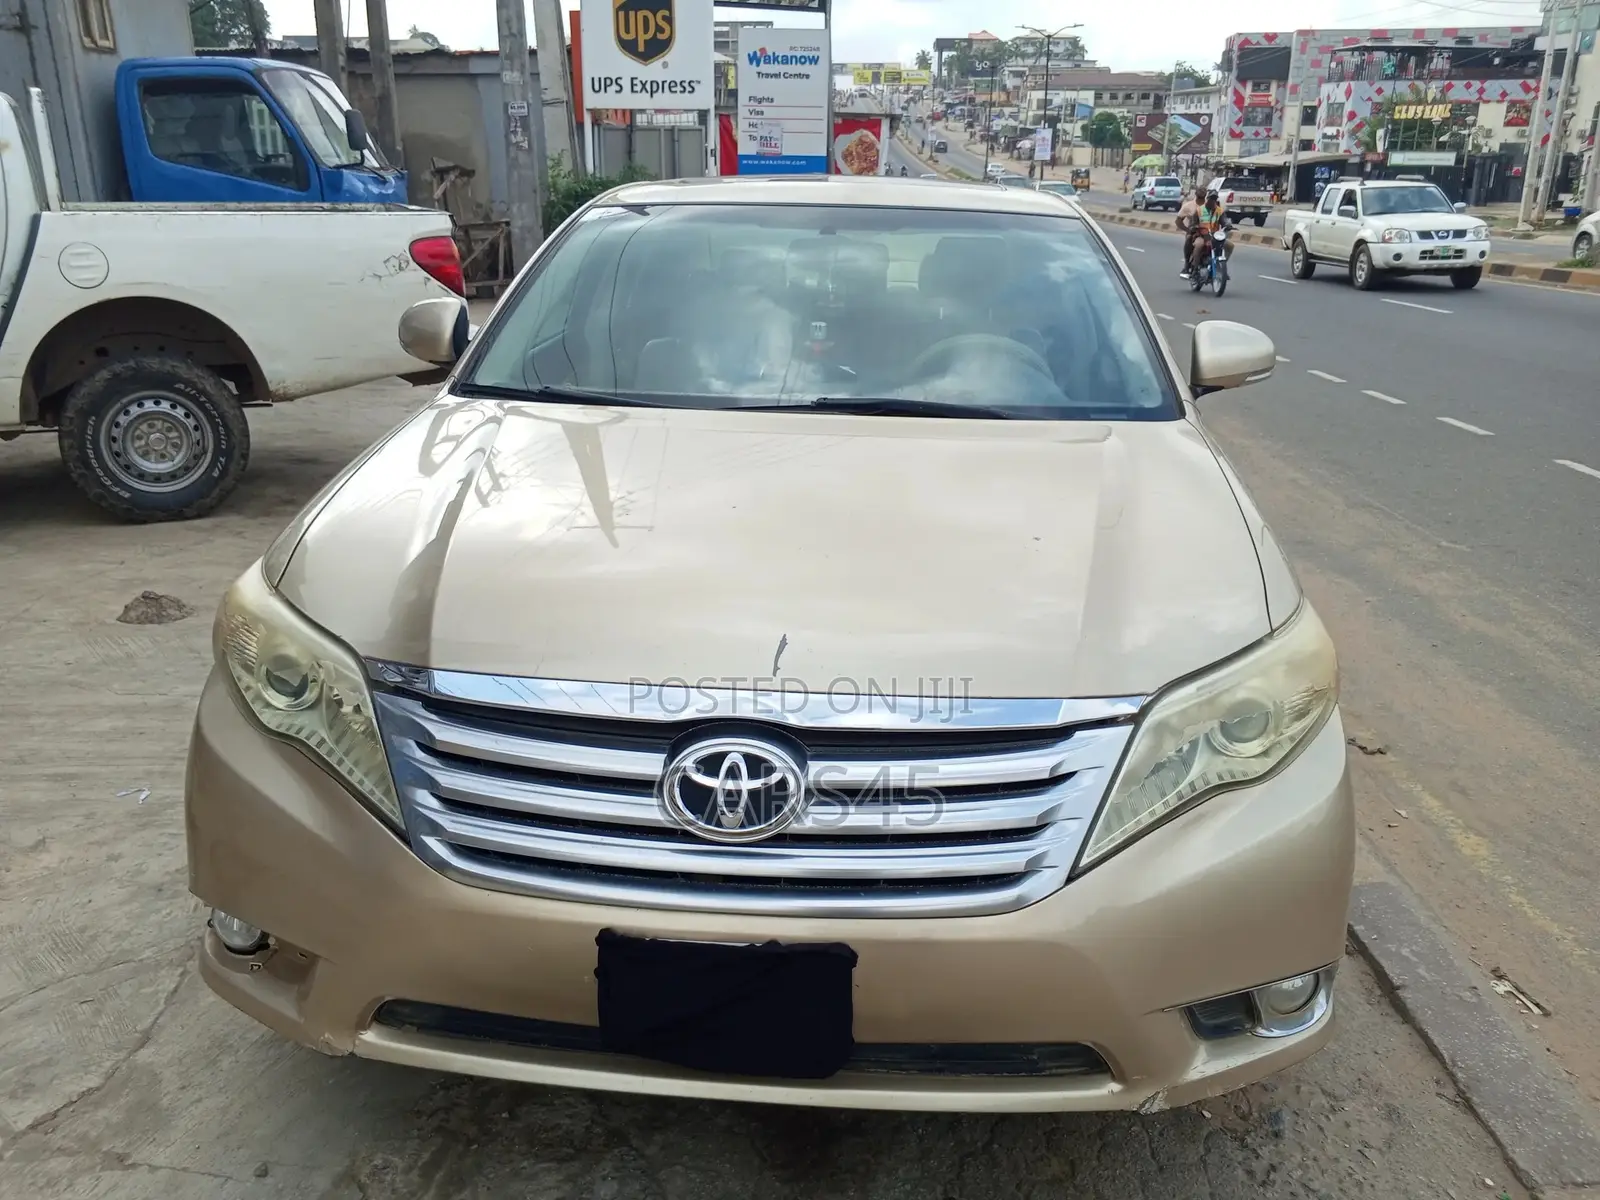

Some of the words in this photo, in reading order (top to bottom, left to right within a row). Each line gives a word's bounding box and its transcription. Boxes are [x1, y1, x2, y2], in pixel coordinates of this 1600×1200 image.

[618, 10, 671, 52] ups
[747, 47, 820, 67] Wakanow
[756, 71, 781, 79] Travel
[783, 72, 811, 80] Centre
[591, 77, 623, 94] UPS
[748, 96, 775, 104] Flights
[748, 108, 764, 116] Visa
